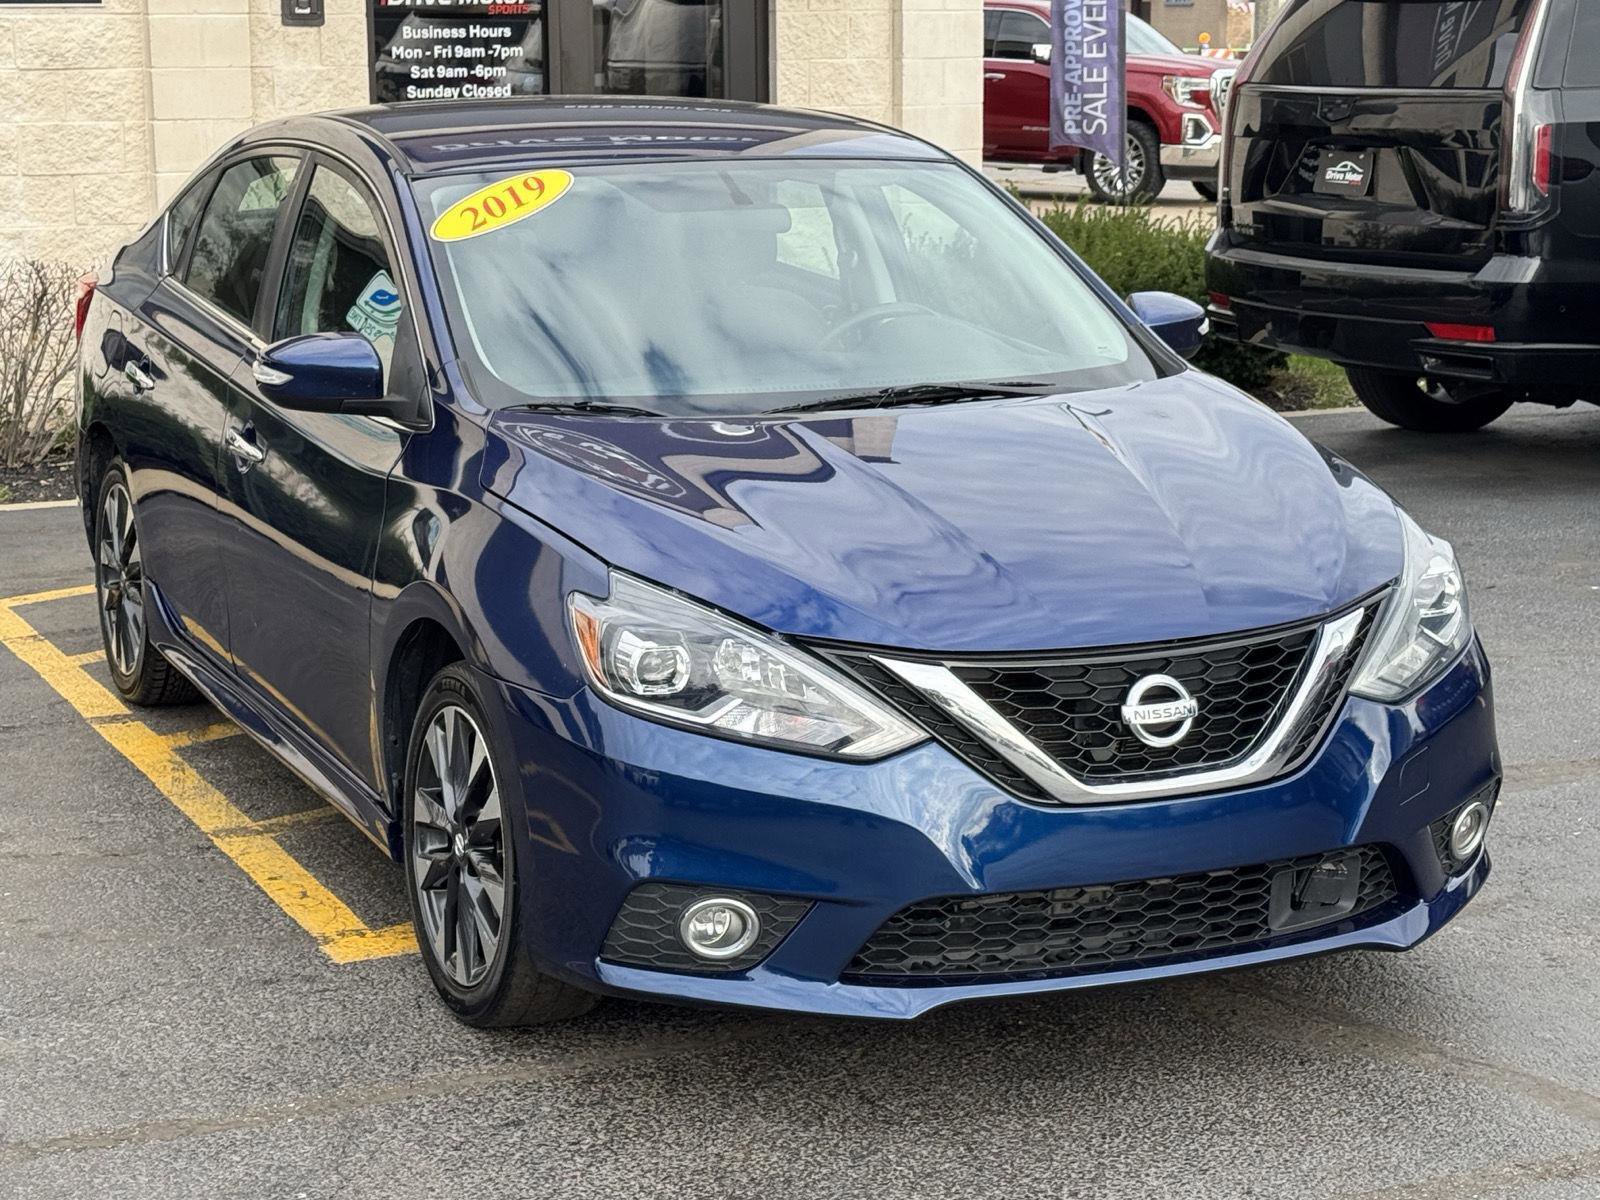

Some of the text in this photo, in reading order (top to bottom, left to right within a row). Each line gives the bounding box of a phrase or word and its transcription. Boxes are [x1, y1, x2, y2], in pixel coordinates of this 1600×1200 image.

[488, 4, 529, 15] SPORTS
[402, 24, 512, 39] Business Hours
[391, 46, 422, 59] Mon
[433, 45, 452, 58] Fri
[454, 45, 485, 58] 9am
[410, 65, 435, 79] Sat
[436, 65, 468, 78] 9am
[1082, 0, 1107, 136] SALE EVE
[406, 83, 512, 99] Sunday Closed
[1325, 170, 1344, 180] Drive
[460, 176, 546, 231] 2019
[1134, 703, 1192, 720] NISSAN
